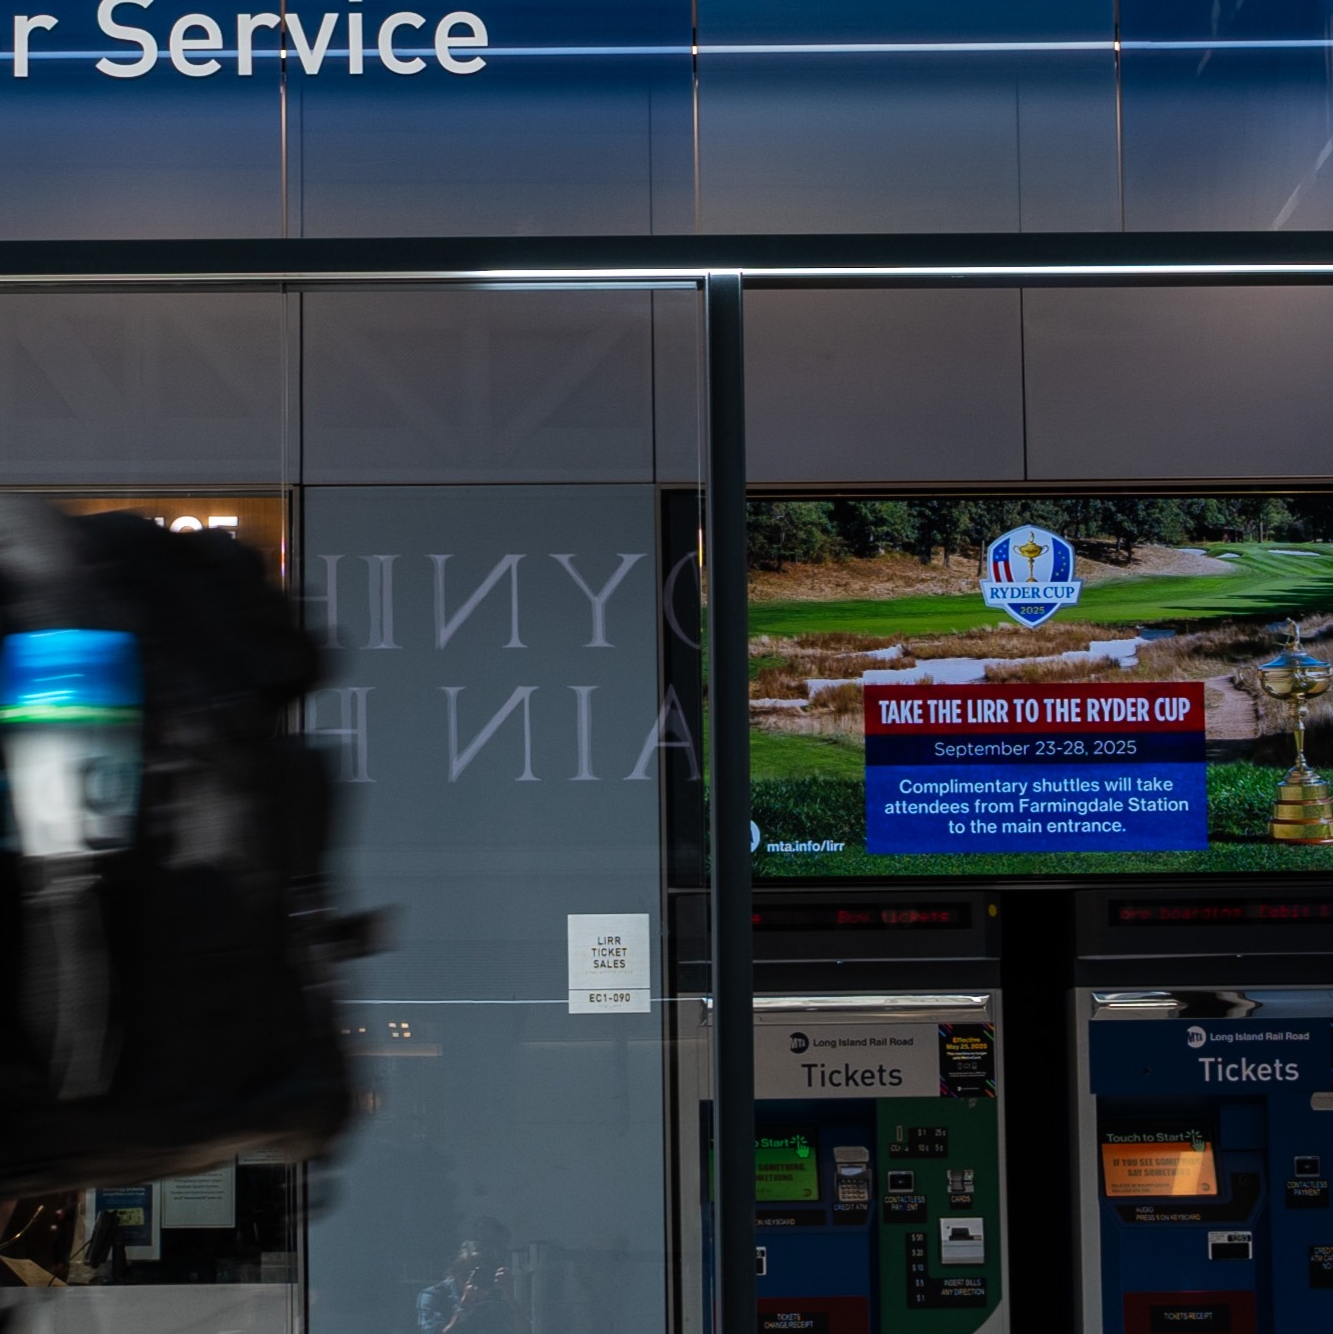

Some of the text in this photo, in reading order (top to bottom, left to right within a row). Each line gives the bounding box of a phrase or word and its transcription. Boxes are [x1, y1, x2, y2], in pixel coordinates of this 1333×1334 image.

[989, 586, 1075, 599] RYDER CUP
[1020, 606, 1045, 615] 2025
[878, 697, 1191, 725] TAKE THE LIRR TO THE RYDER CUP
[934, 740, 1137, 759] September 23-28, 2025
[899, 776, 1174, 797] Complimentary shuttles will take
[884, 797, 1189, 816] attendees from Farmingdale Station
[948, 818, 1127, 834] to the main entrance.
[766, 839, 845, 852] mta.info/lirr
[597, 936, 622, 946] LIRR
[591, 948, 628, 957] TICKET
[593, 959, 626, 969] SALES
[588, 993, 631, 1003] EC1-090
[813, 1038, 837, 1049] Long
[838, 1037, 867, 1047] Island
[869, 1037, 887, 1047] Rail
[890, 1036, 914, 1047] Road
[1210, 1032, 1234, 1044] Long
[1235, 1031, 1264, 1041] Island
[1266, 1031, 1284, 1041] Rail
[1285, 1031, 1311, 1041] Road
[1198, 1056, 1300, 1082] Tickets
[801, 1063, 903, 1088] Tickets
[760, 1138, 789, 1148] Start
[1106, 1132, 1184, 1143] Touch to Start
[1121, 1159, 1139, 1167] YOU
[1286, 1180, 1328, 1189] CONTACTLESS
[1294, 1188, 1321, 1196] PAYMENT
[951, 1195, 971, 1203] CARDS
[953, 1288, 985, 1296] DIRECTION
